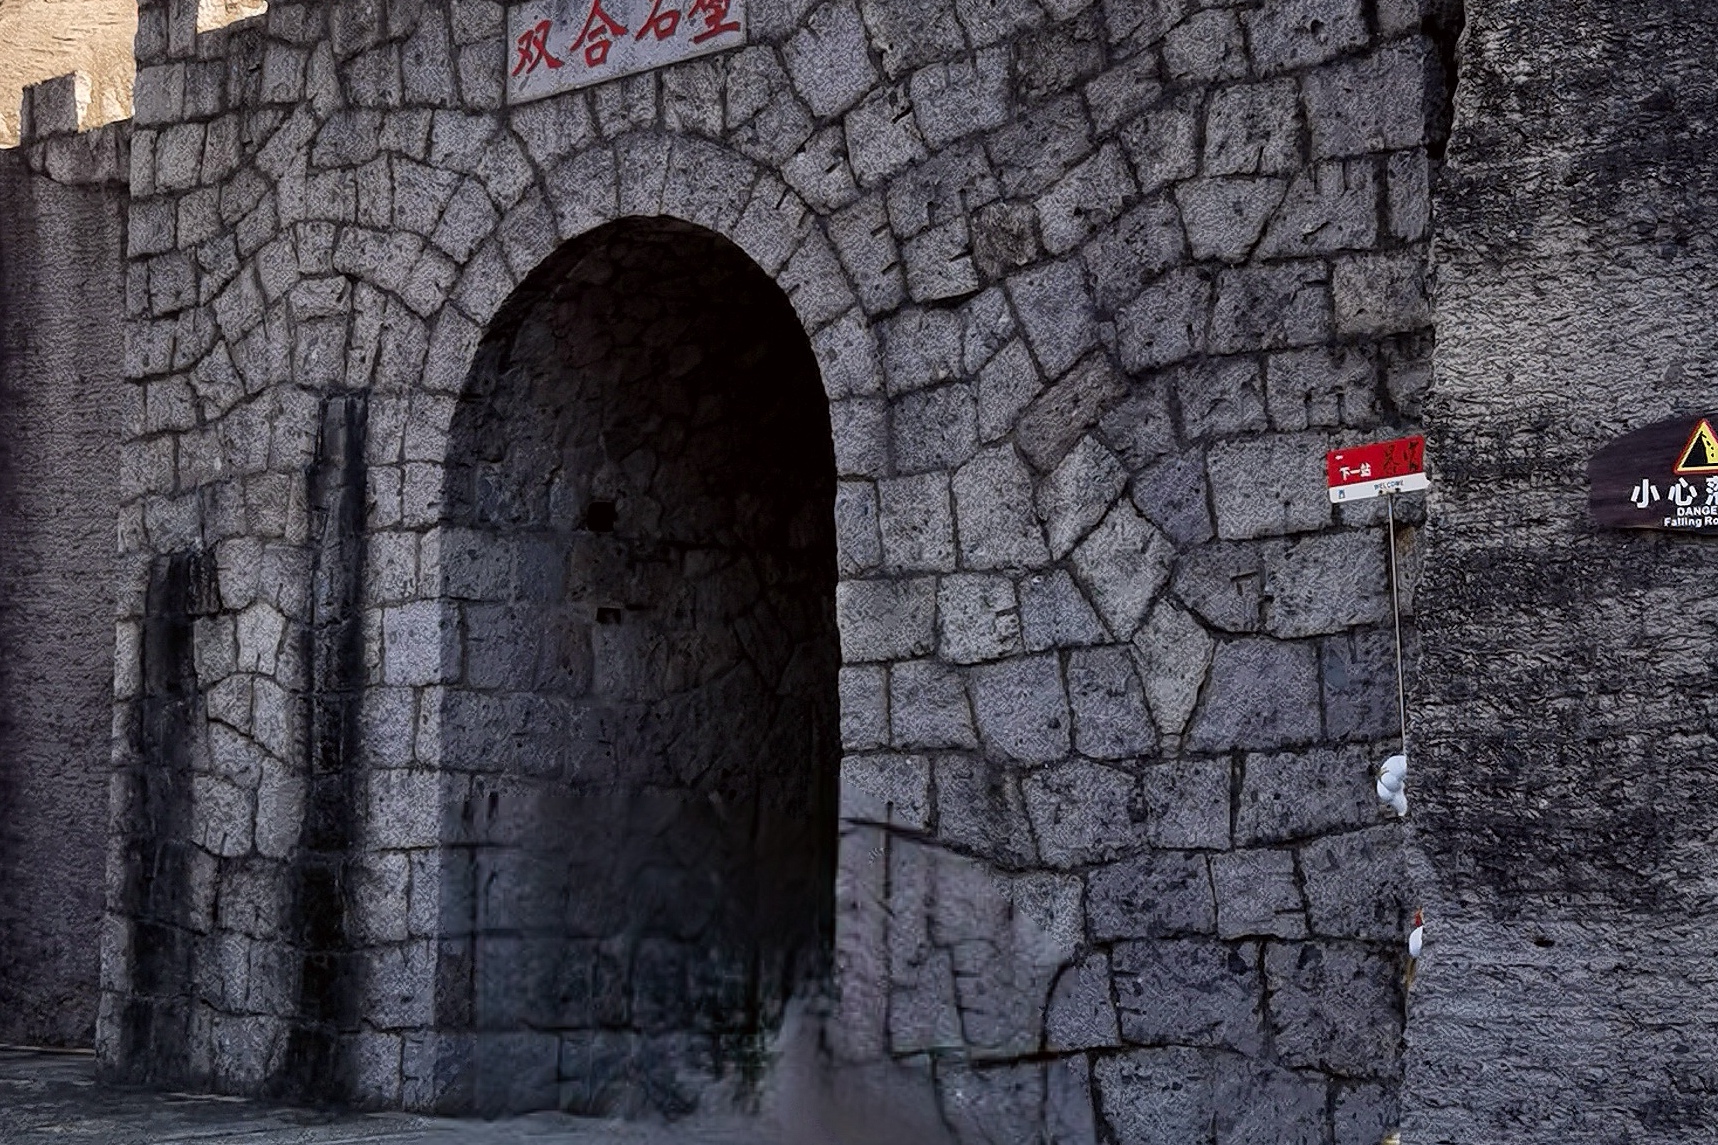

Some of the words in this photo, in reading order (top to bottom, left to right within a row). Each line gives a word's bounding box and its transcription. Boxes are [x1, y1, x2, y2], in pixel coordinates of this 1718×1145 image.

[1339, 461, 1372, 482] 下一站
[1663, 517, 1703, 528] Falling
